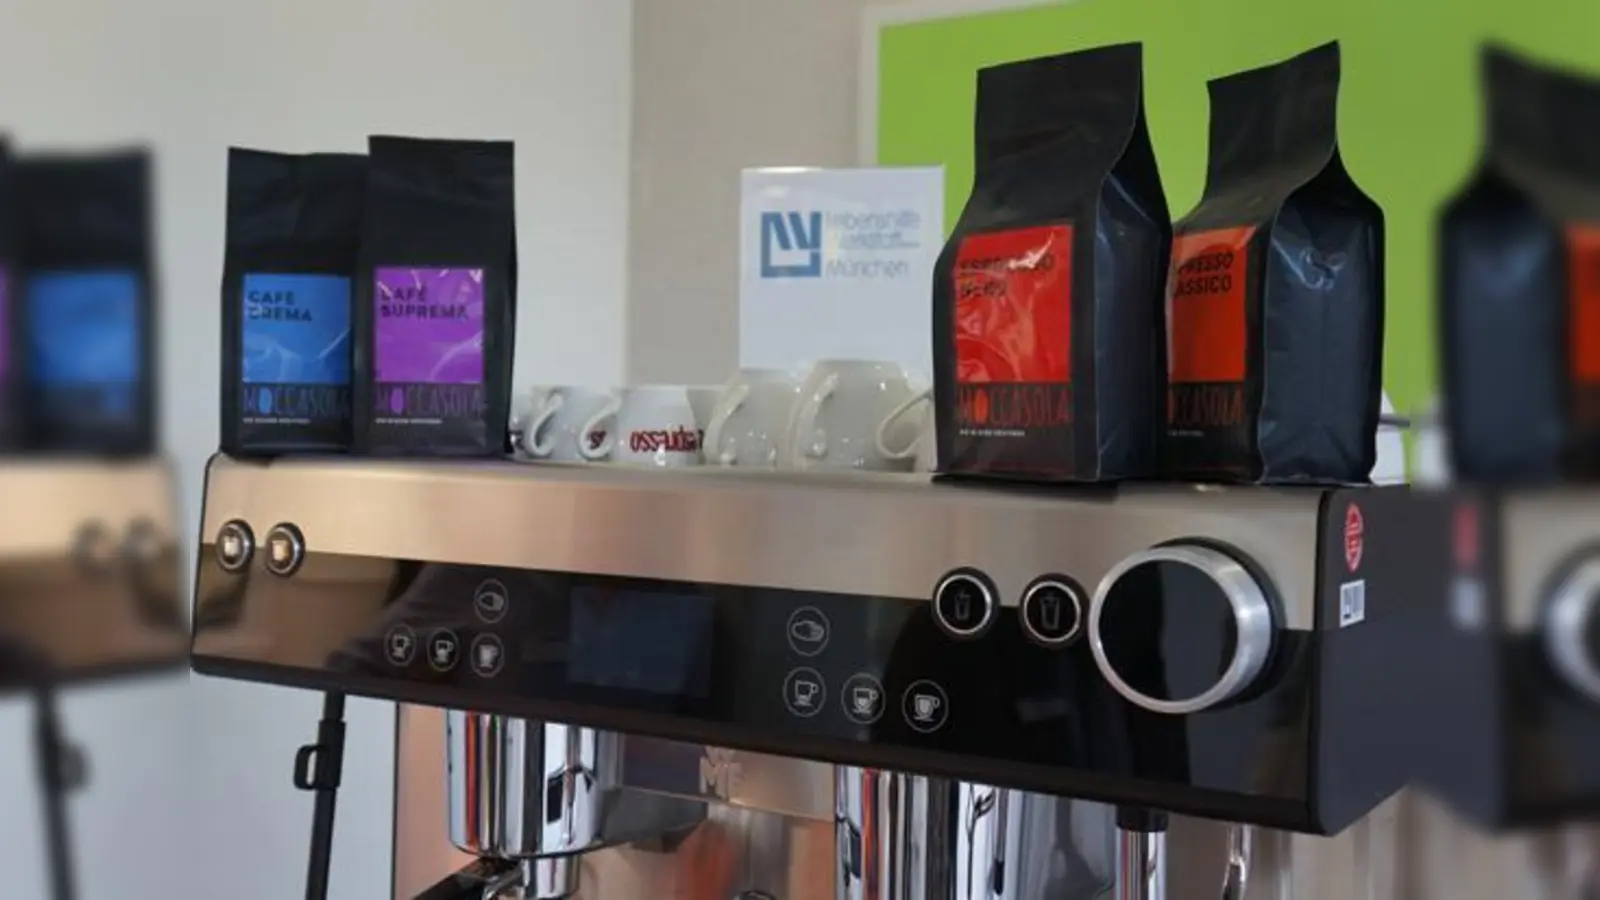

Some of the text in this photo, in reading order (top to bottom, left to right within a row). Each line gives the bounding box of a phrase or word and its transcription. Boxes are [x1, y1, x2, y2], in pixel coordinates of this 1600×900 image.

[960, 253, 1055, 272] ESPRO
[246, 304, 313, 321] CREMA
[380, 302, 469, 321] SUPREMA
